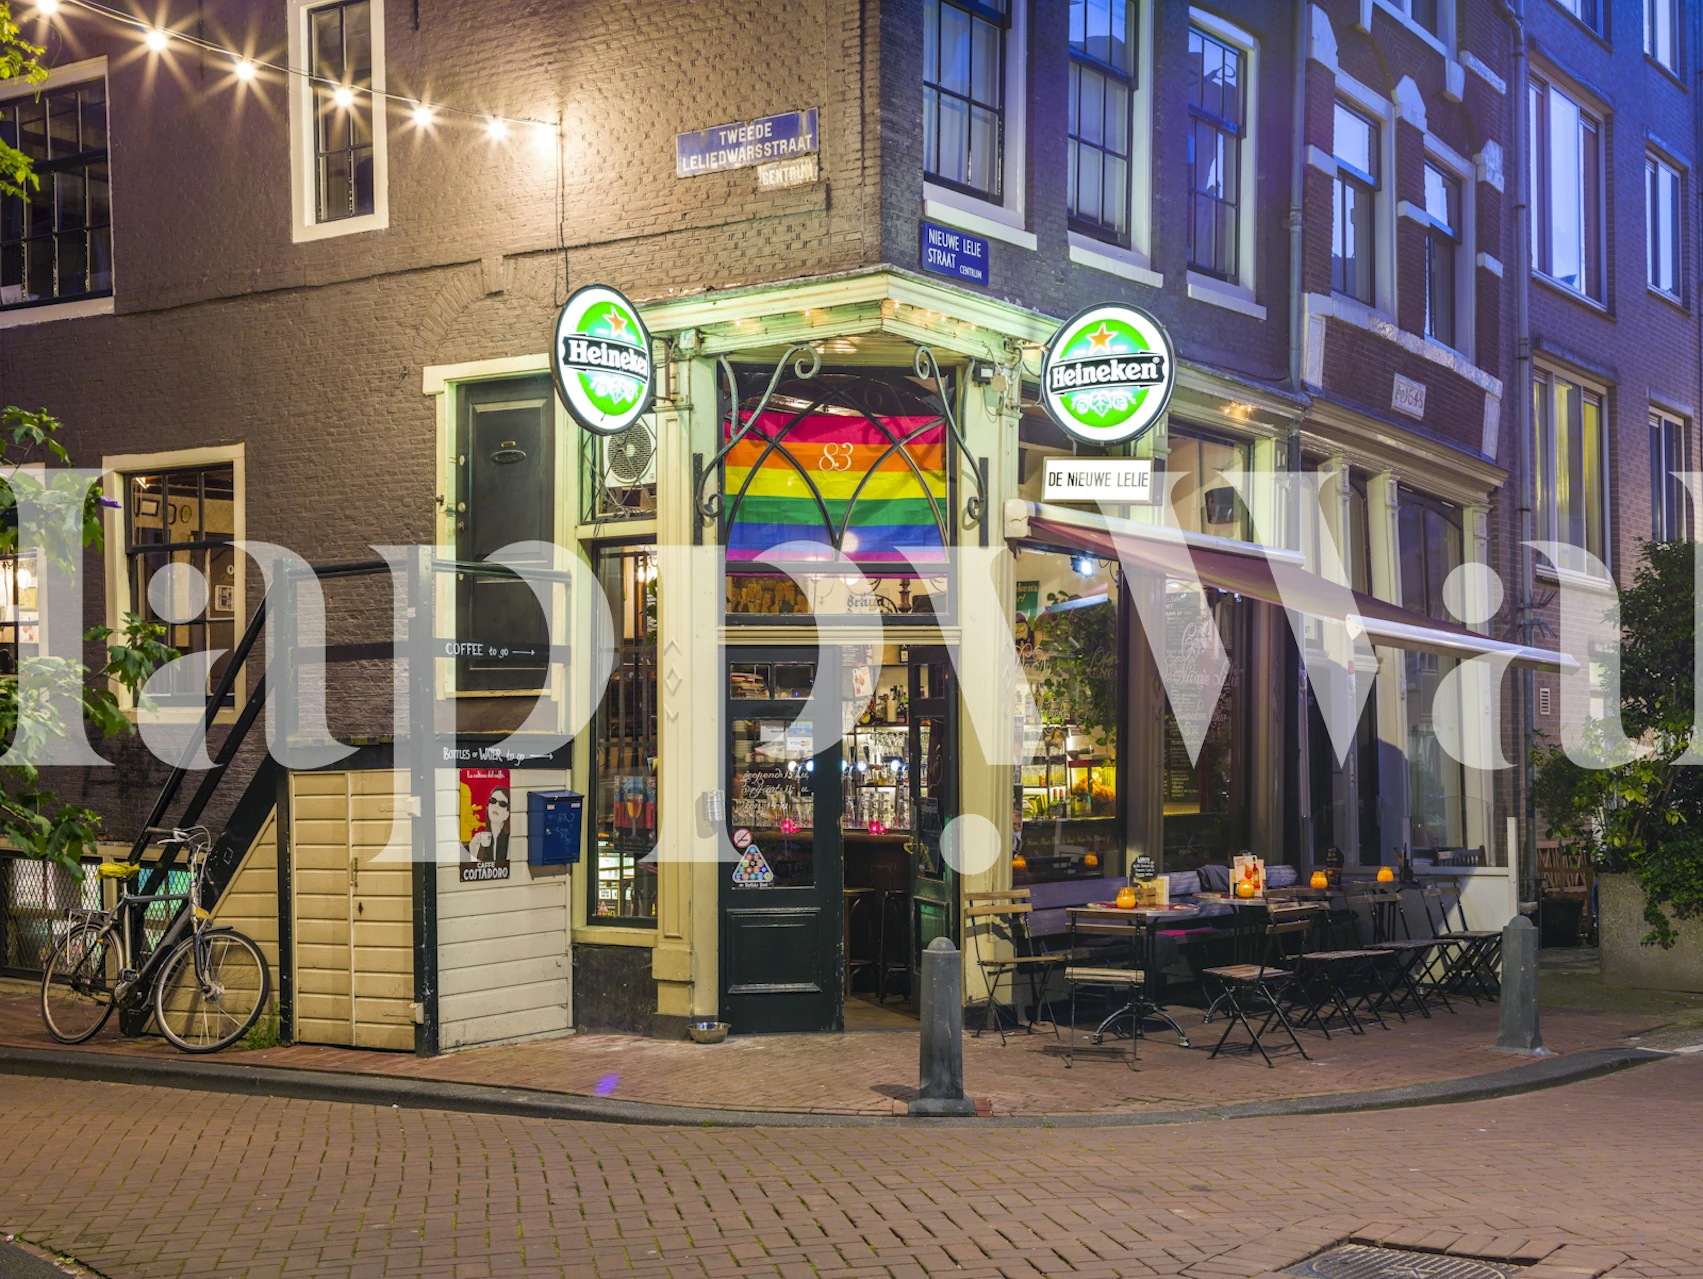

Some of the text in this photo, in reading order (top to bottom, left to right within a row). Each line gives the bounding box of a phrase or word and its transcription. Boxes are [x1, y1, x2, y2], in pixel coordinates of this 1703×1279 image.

[719, 122, 773, 146] TWEEDE
[682, 135, 813, 172] LELIEDWARSSTRAAT
[928, 228, 982, 258] NIEUWE LELIE
[927, 248, 983, 280] STRAAT CENTRUM
[1051, 358, 1159, 389] Heineken
[818, 441, 855, 472] 83
[1048, 471, 1149, 487] DE NIEUWE LELIE
[445, 642, 509, 659] COFFEE to go
[506, 749, 514, 761] to
[513, 753, 526, 767] go
